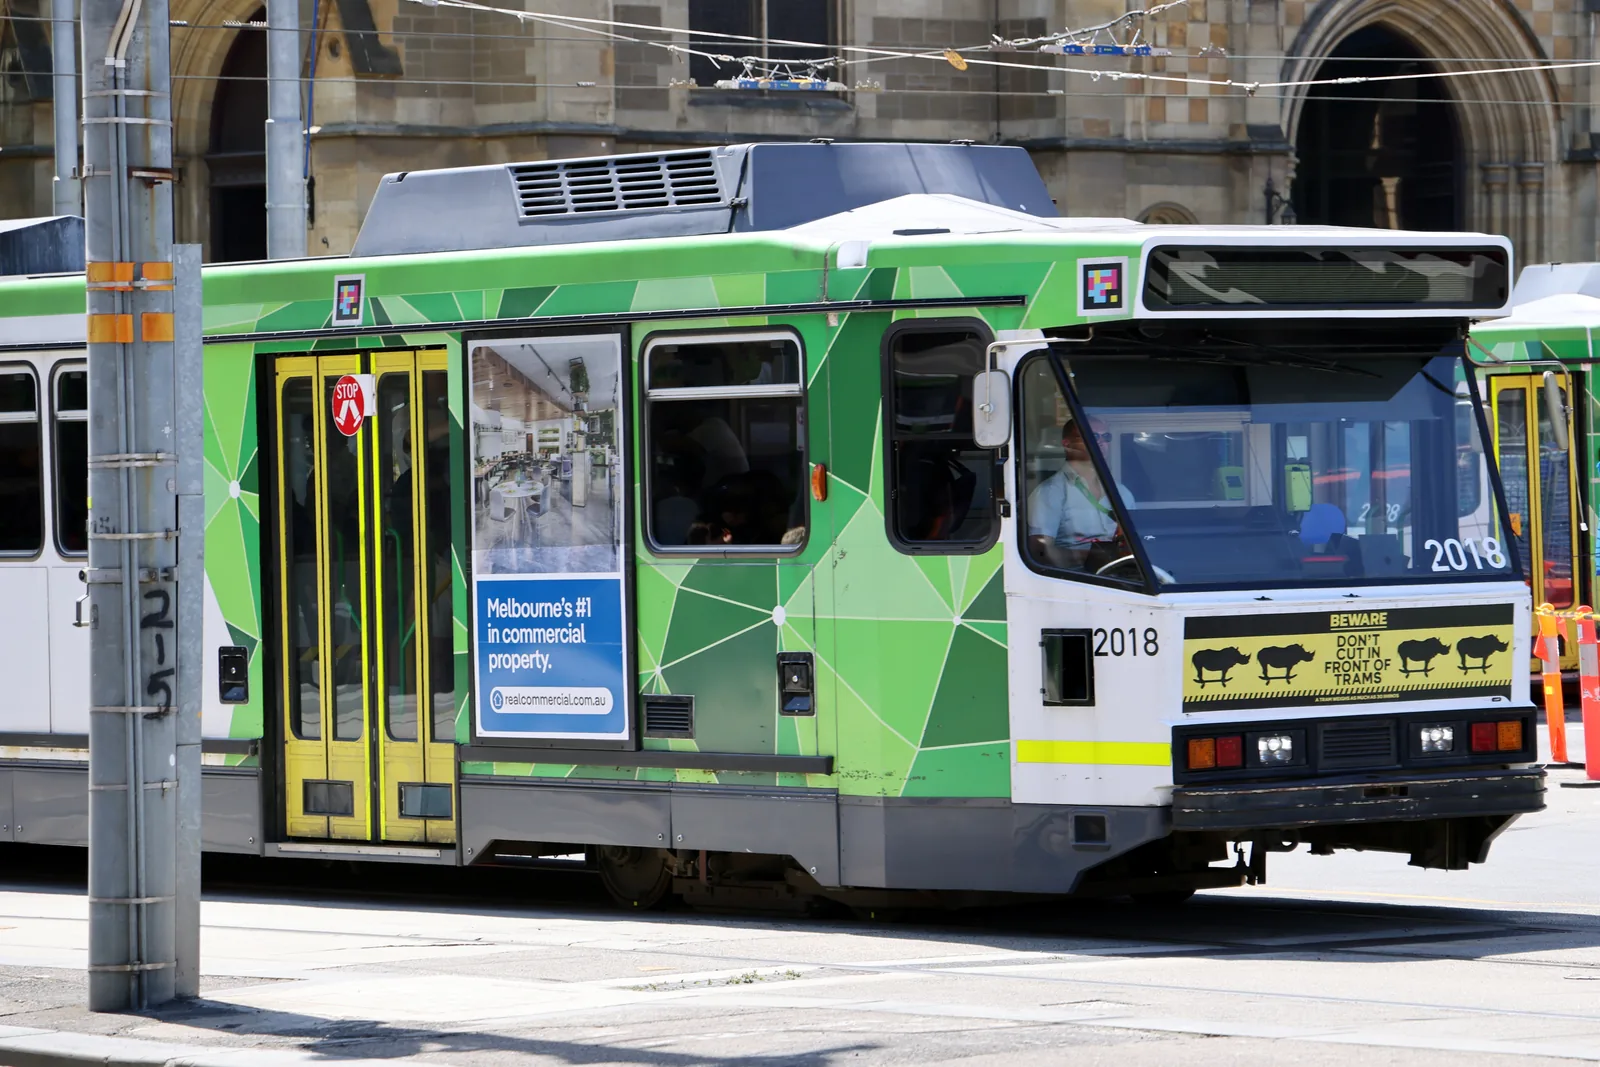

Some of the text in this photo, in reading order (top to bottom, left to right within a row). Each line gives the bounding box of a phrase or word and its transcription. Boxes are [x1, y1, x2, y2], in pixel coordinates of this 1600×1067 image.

[336, 382, 359, 400] STOP
[1424, 536, 1507, 572] 2018
[487, 596, 592, 618] Melbourne's #1
[1330, 612, 1388, 627] BEWARE
[487, 622, 586, 644] in commercial
[1336, 633, 1380, 647] DON'T
[1093, 627, 1159, 657] 2018
[1336, 646, 1381, 660] CUT IN
[488, 649, 553, 674] property.
[1325, 658, 1392, 673] FRONT OF
[1334, 672, 1382, 685] TRAMS
[504, 693, 606, 707] realcommercial.com.au
